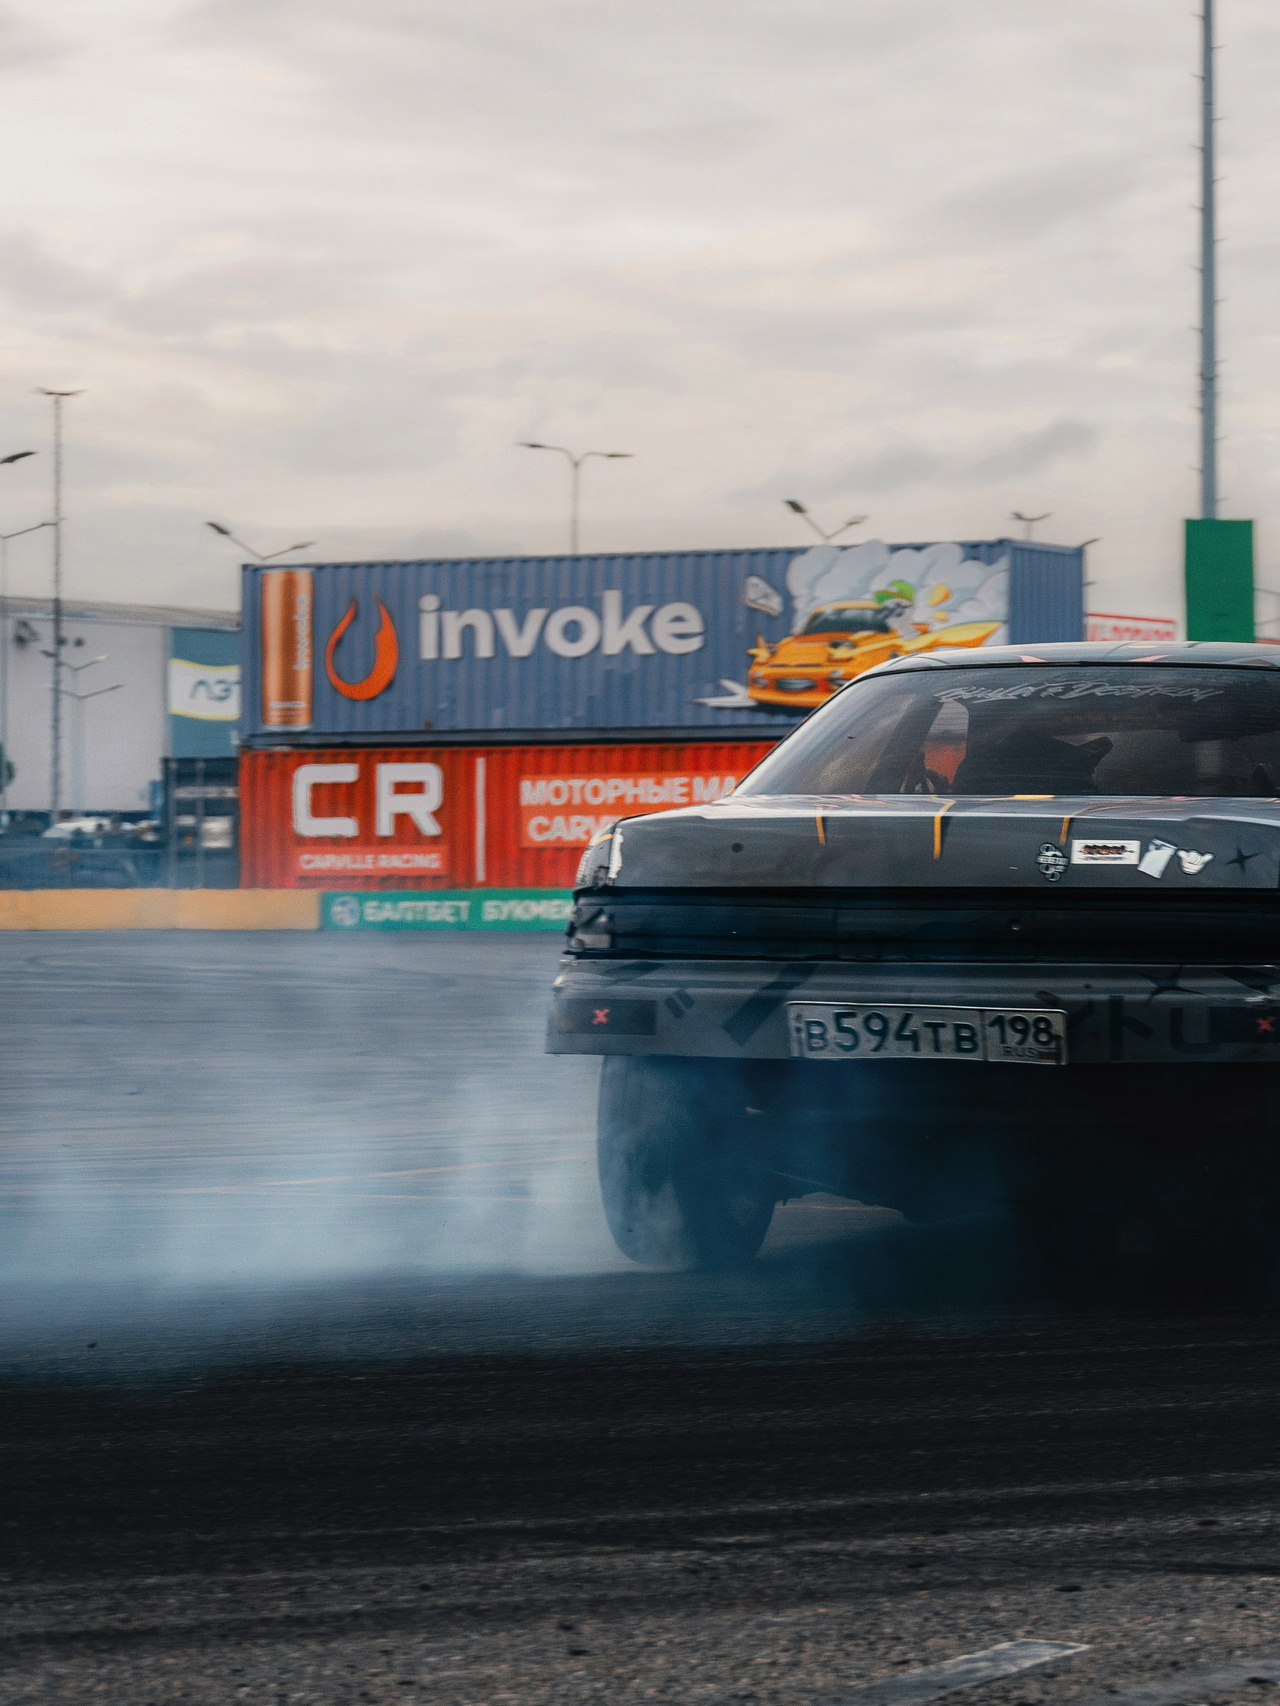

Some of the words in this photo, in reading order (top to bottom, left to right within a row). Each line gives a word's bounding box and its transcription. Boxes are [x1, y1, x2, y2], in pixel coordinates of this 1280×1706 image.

[418, 588, 706, 661] invoke
[292, 762, 444, 837] CR
[519, 775, 690, 806] МОТОРНЫЕ
[364, 900, 470, 923] БАЛТБЕТ
[987, 1013, 1055, 1047] 198
[1002, 1045, 1039, 1059] RUS
